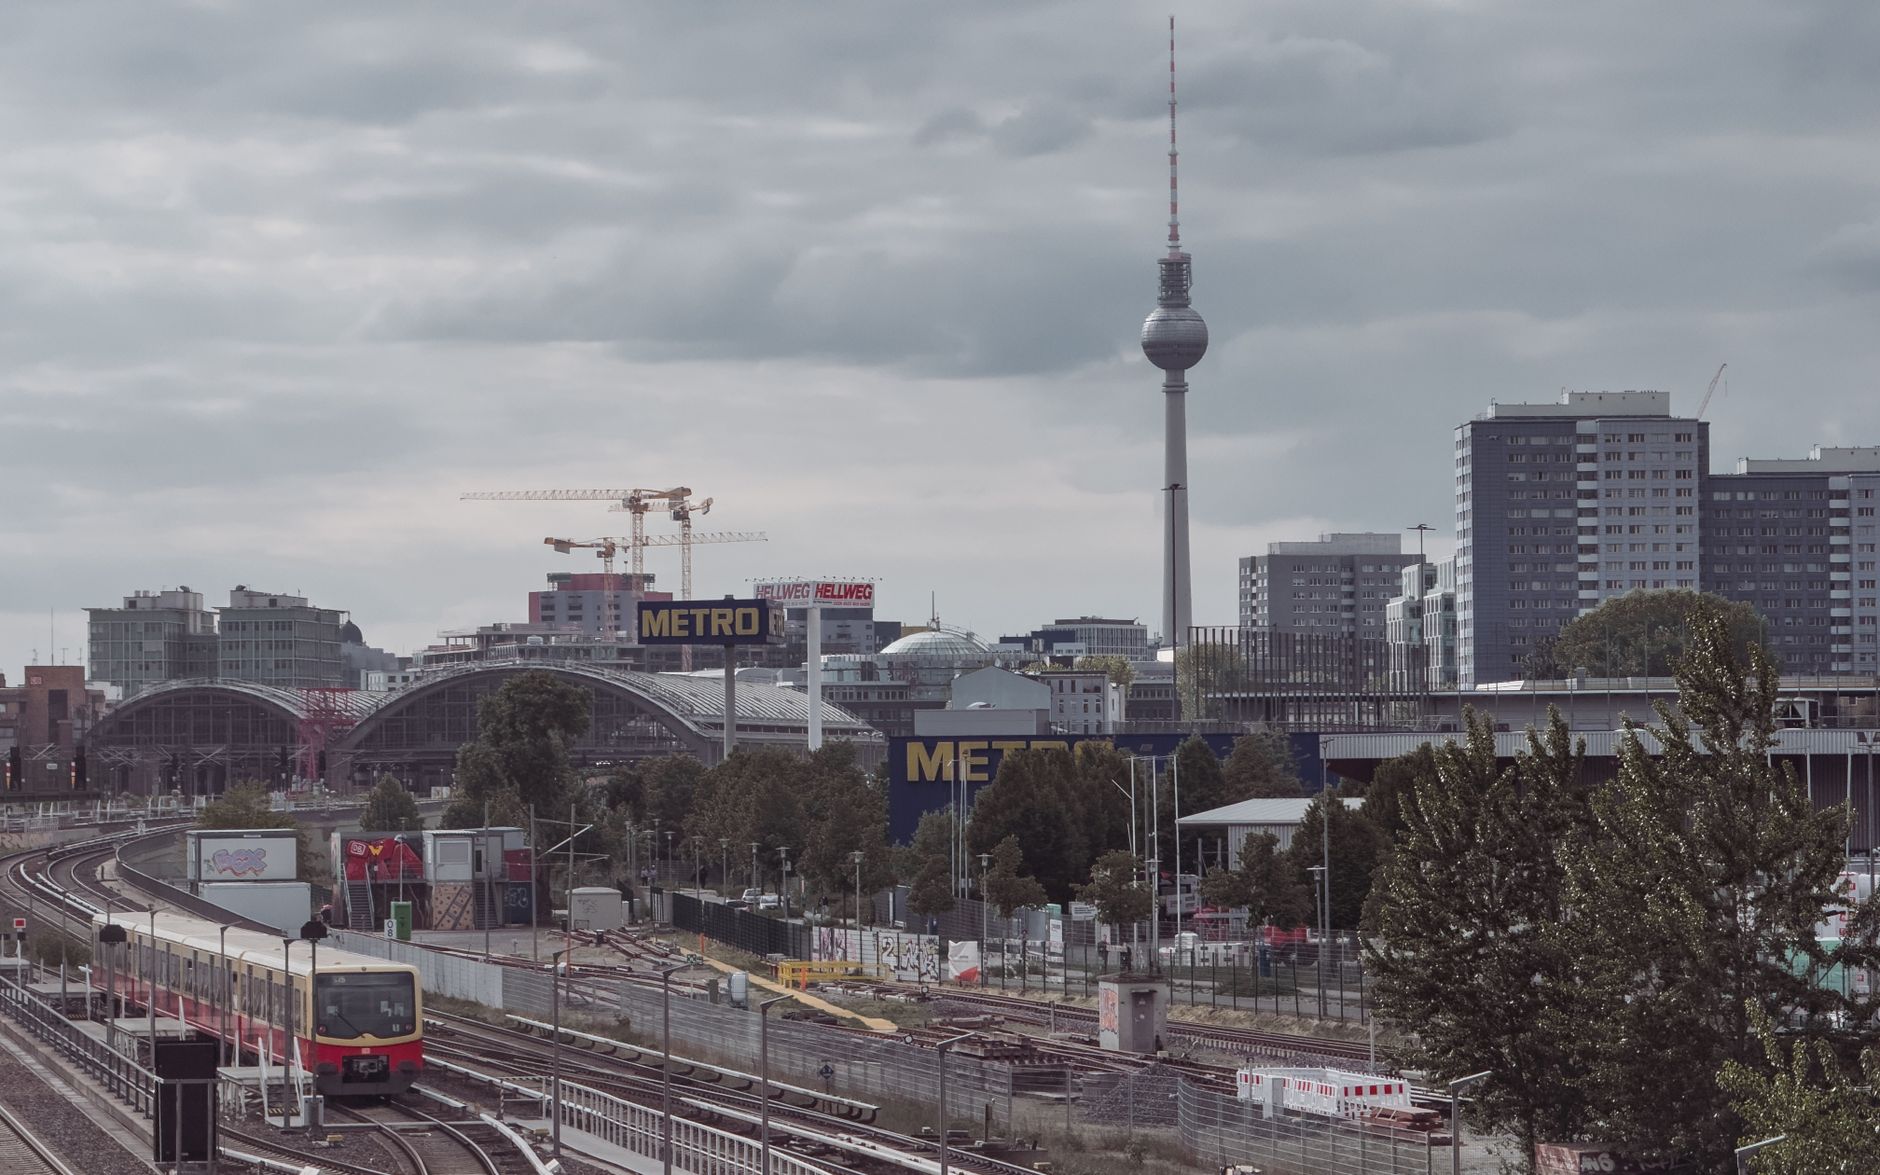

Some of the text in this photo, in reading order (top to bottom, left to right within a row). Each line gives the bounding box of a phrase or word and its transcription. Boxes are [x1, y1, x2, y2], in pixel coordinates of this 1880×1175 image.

[756, 583, 810, 600] HELLWEG
[815, 583, 873, 600] HELLWEG
[642, 607, 760, 637] METRO
[907, 741, 1114, 781] MET
